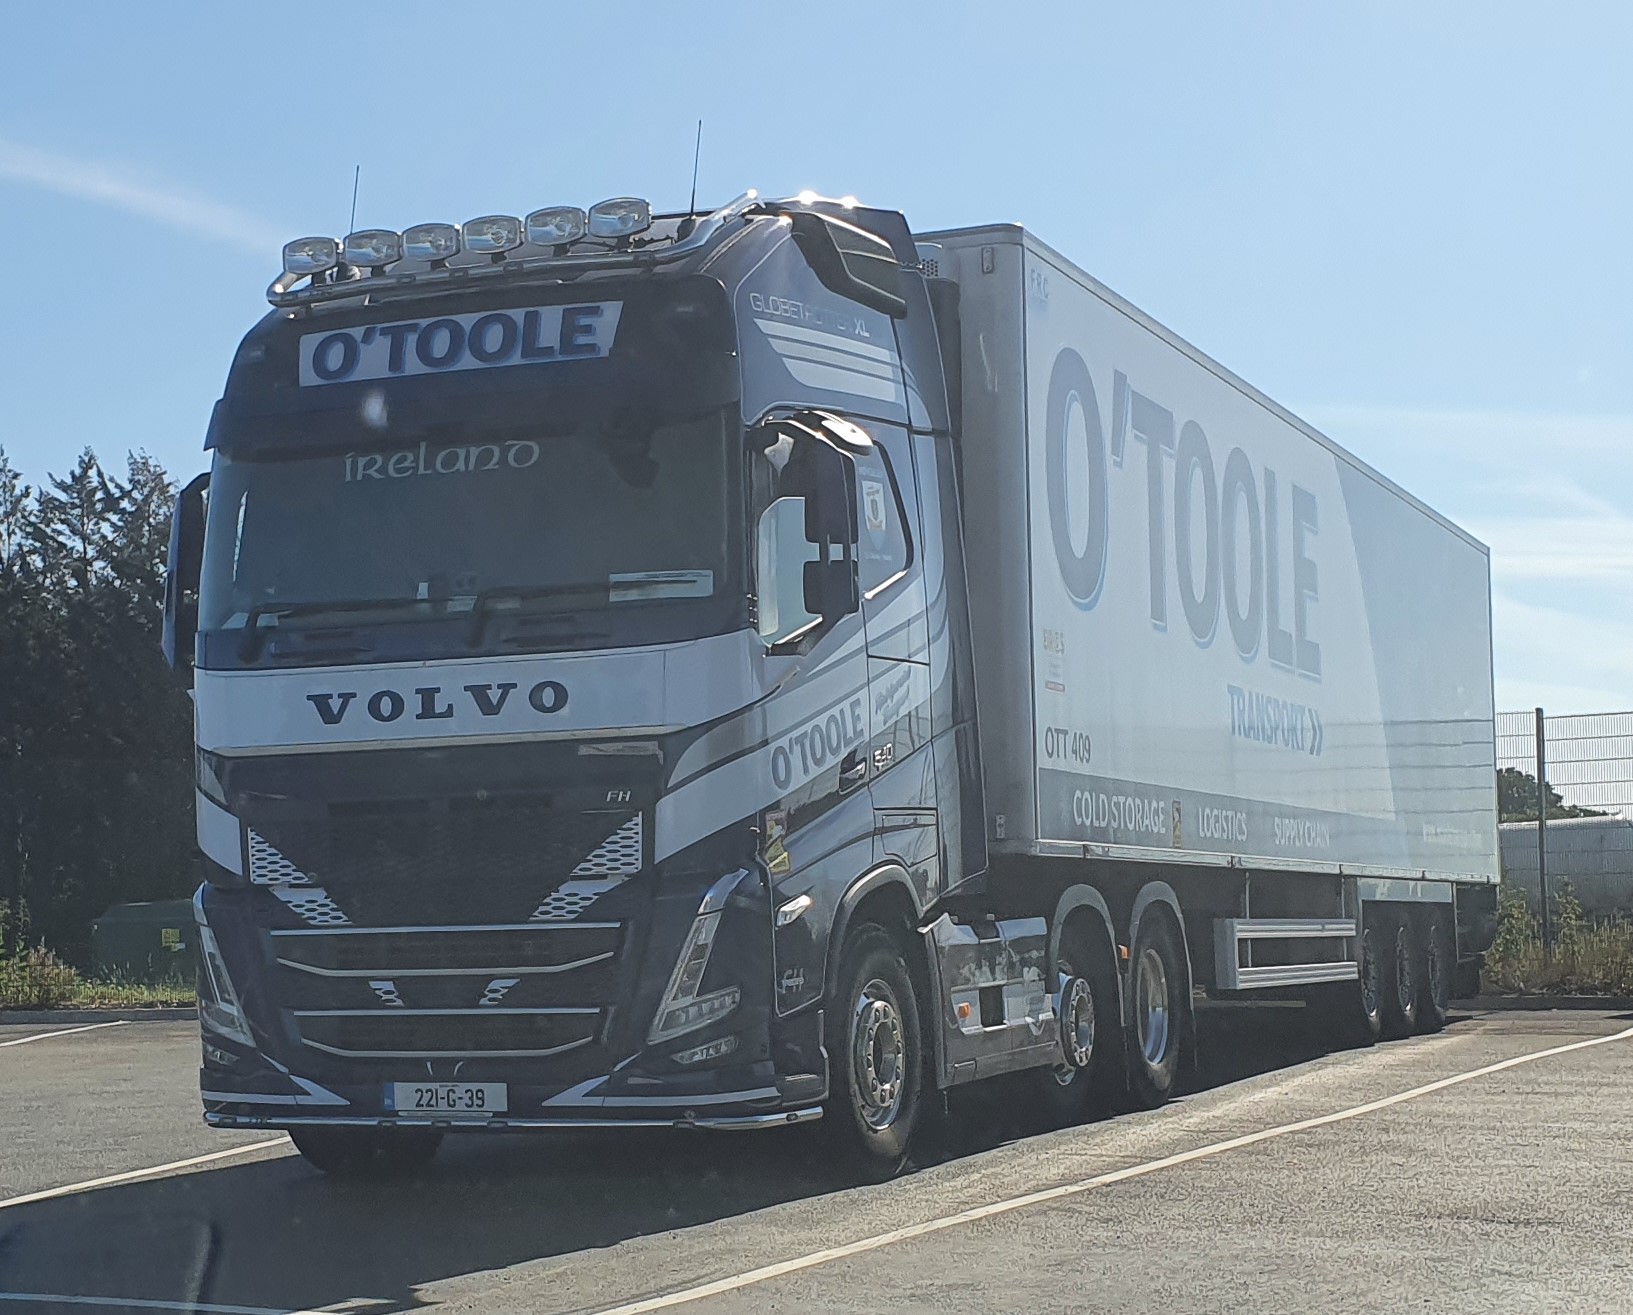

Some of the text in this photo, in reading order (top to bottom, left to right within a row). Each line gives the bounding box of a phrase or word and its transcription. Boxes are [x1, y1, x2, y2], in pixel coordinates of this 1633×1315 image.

[312, 305, 604, 381] O'TOOLE
[1046, 347, 1321, 683] O'TOOLE
[306, 680, 569, 725] VOLVO
[1227, 683, 1306, 752] TRANSPORT
[771, 697, 865, 791] O'TOOLE
[1045, 726, 1091, 764] OTT 409
[606, 790, 631, 801] FH
[1073, 789, 1166, 834] COLD STORAGE
[1198, 807, 1248, 842] LOGISTICS
[1274, 816, 1330, 847] SUPPLY CHAIN
[414, 1087, 486, 1109] 221-G-39
